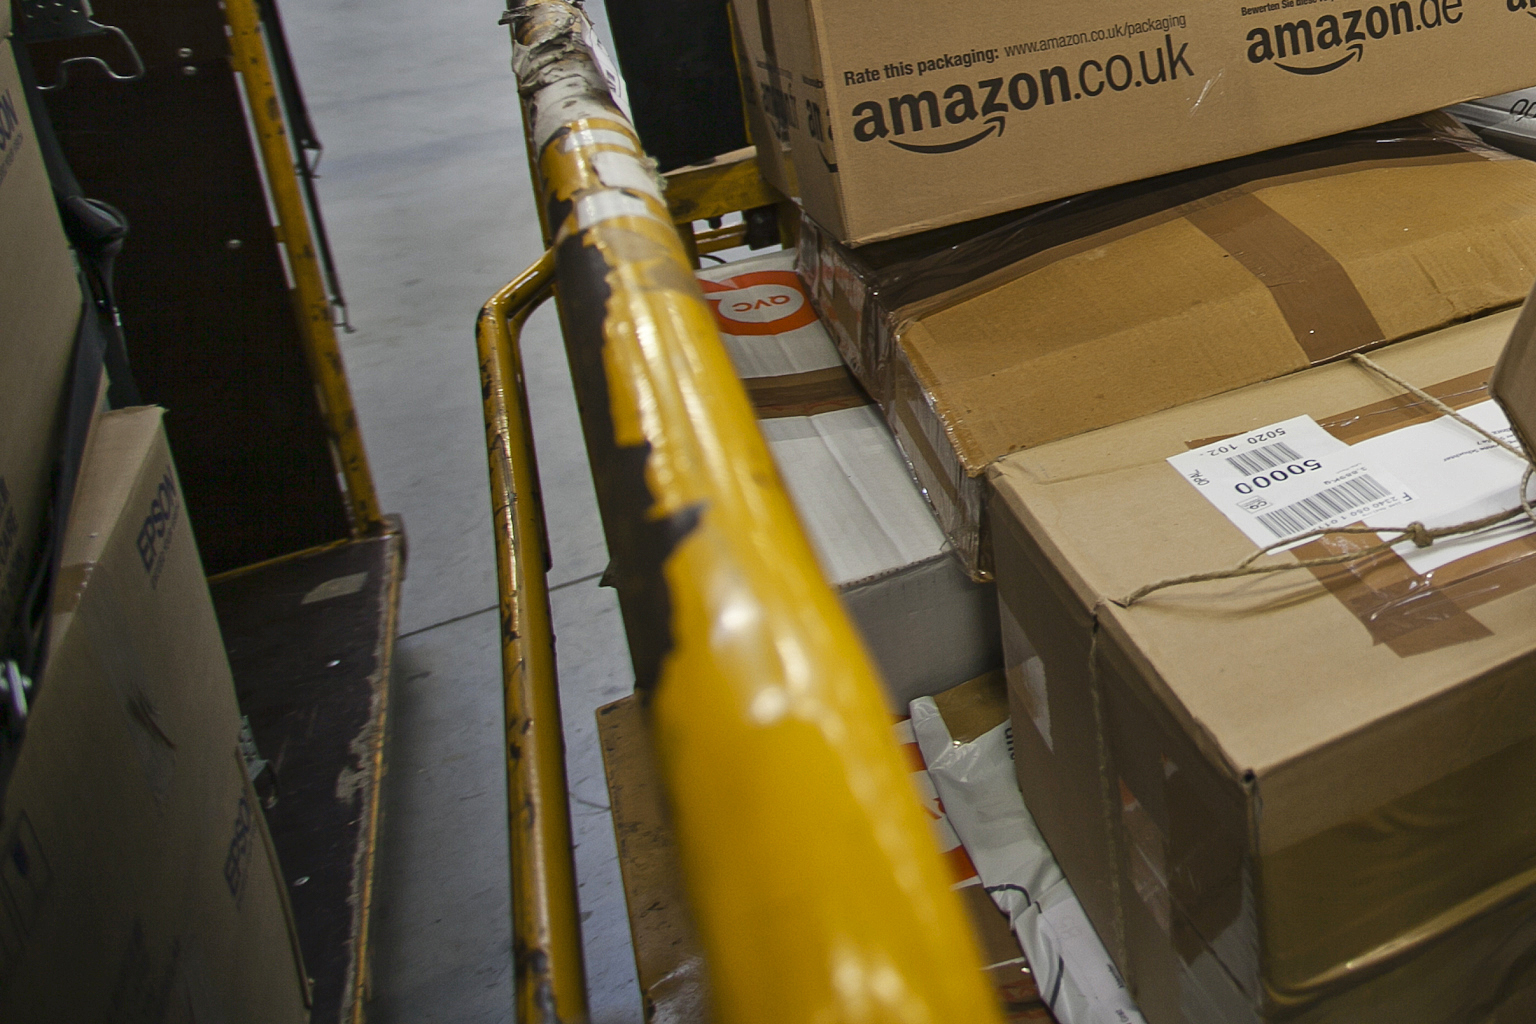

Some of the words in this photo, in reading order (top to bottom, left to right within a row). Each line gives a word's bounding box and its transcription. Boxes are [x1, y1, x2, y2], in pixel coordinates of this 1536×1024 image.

[1241, 0, 1281, 17] Bewerten
[844, 68, 881, 87] Rate
[883, 60, 914, 80] this
[917, 47, 1000, 75] packaging:
[1003, 14, 1187, 58] www.amazon.co.uk/packaging
[851, 33, 1196, 143] amazon.co.uk
[732, 296, 789, 311] QVC
[1246, 426, 1285, 445] 5020
[1234, 457, 1321, 495] 50000
[1400, 491, 1412, 502] F
[135, 463, 178, 573] EPSON
